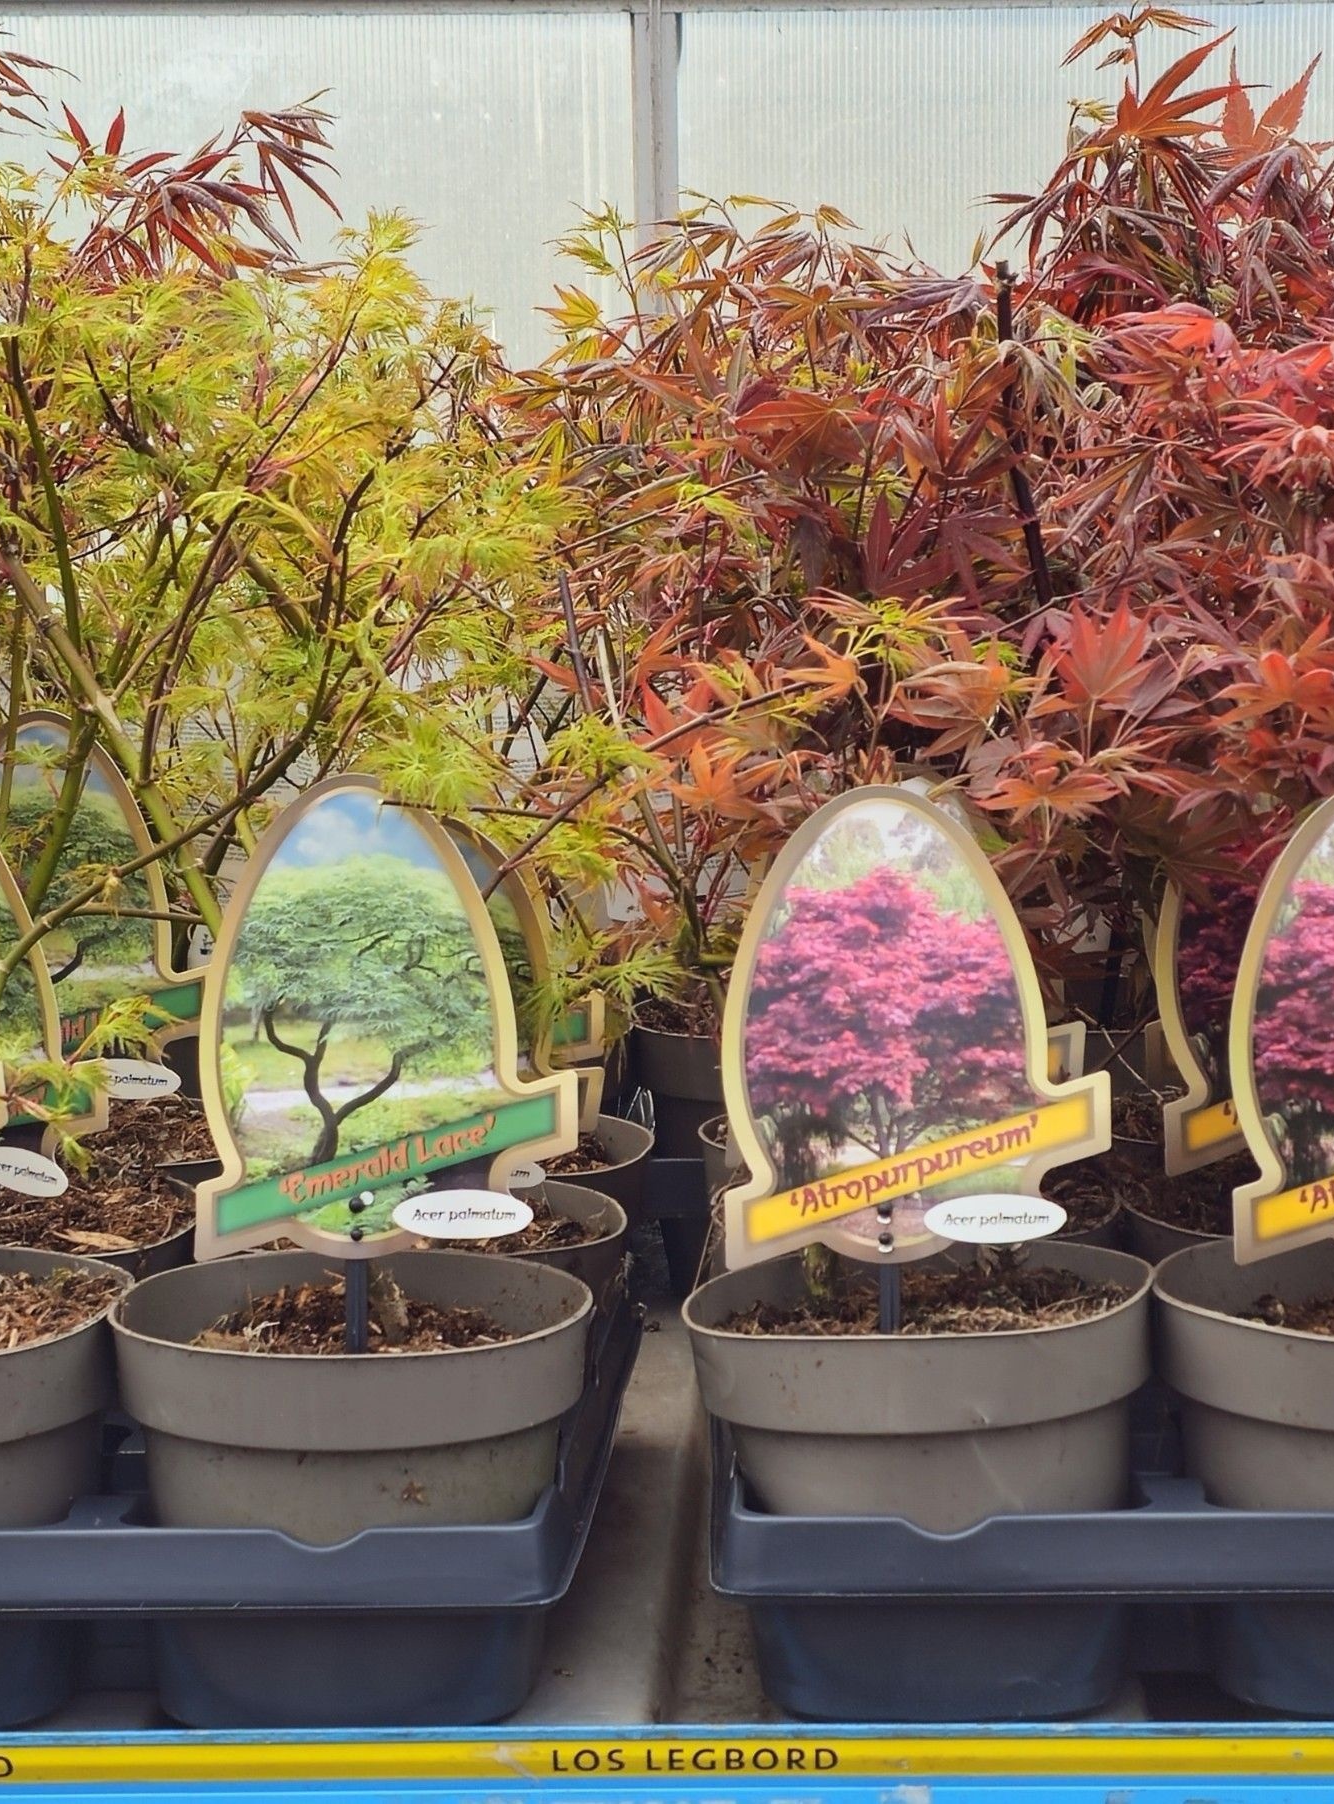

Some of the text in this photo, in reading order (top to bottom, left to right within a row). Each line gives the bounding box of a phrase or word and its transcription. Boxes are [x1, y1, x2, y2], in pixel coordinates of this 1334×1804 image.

[279, 1113, 496, 1204] 'Emerald Lace'
[790, 1114, 1039, 1217] 'Atropurpureum'
[14, 1166, 58, 1185] palmatum
[412, 1208, 516, 1222] Acer palmatum
[944, 1212, 1050, 1226] Acer palmatum
[552, 1747, 840, 1773] LOS LEGBORD
